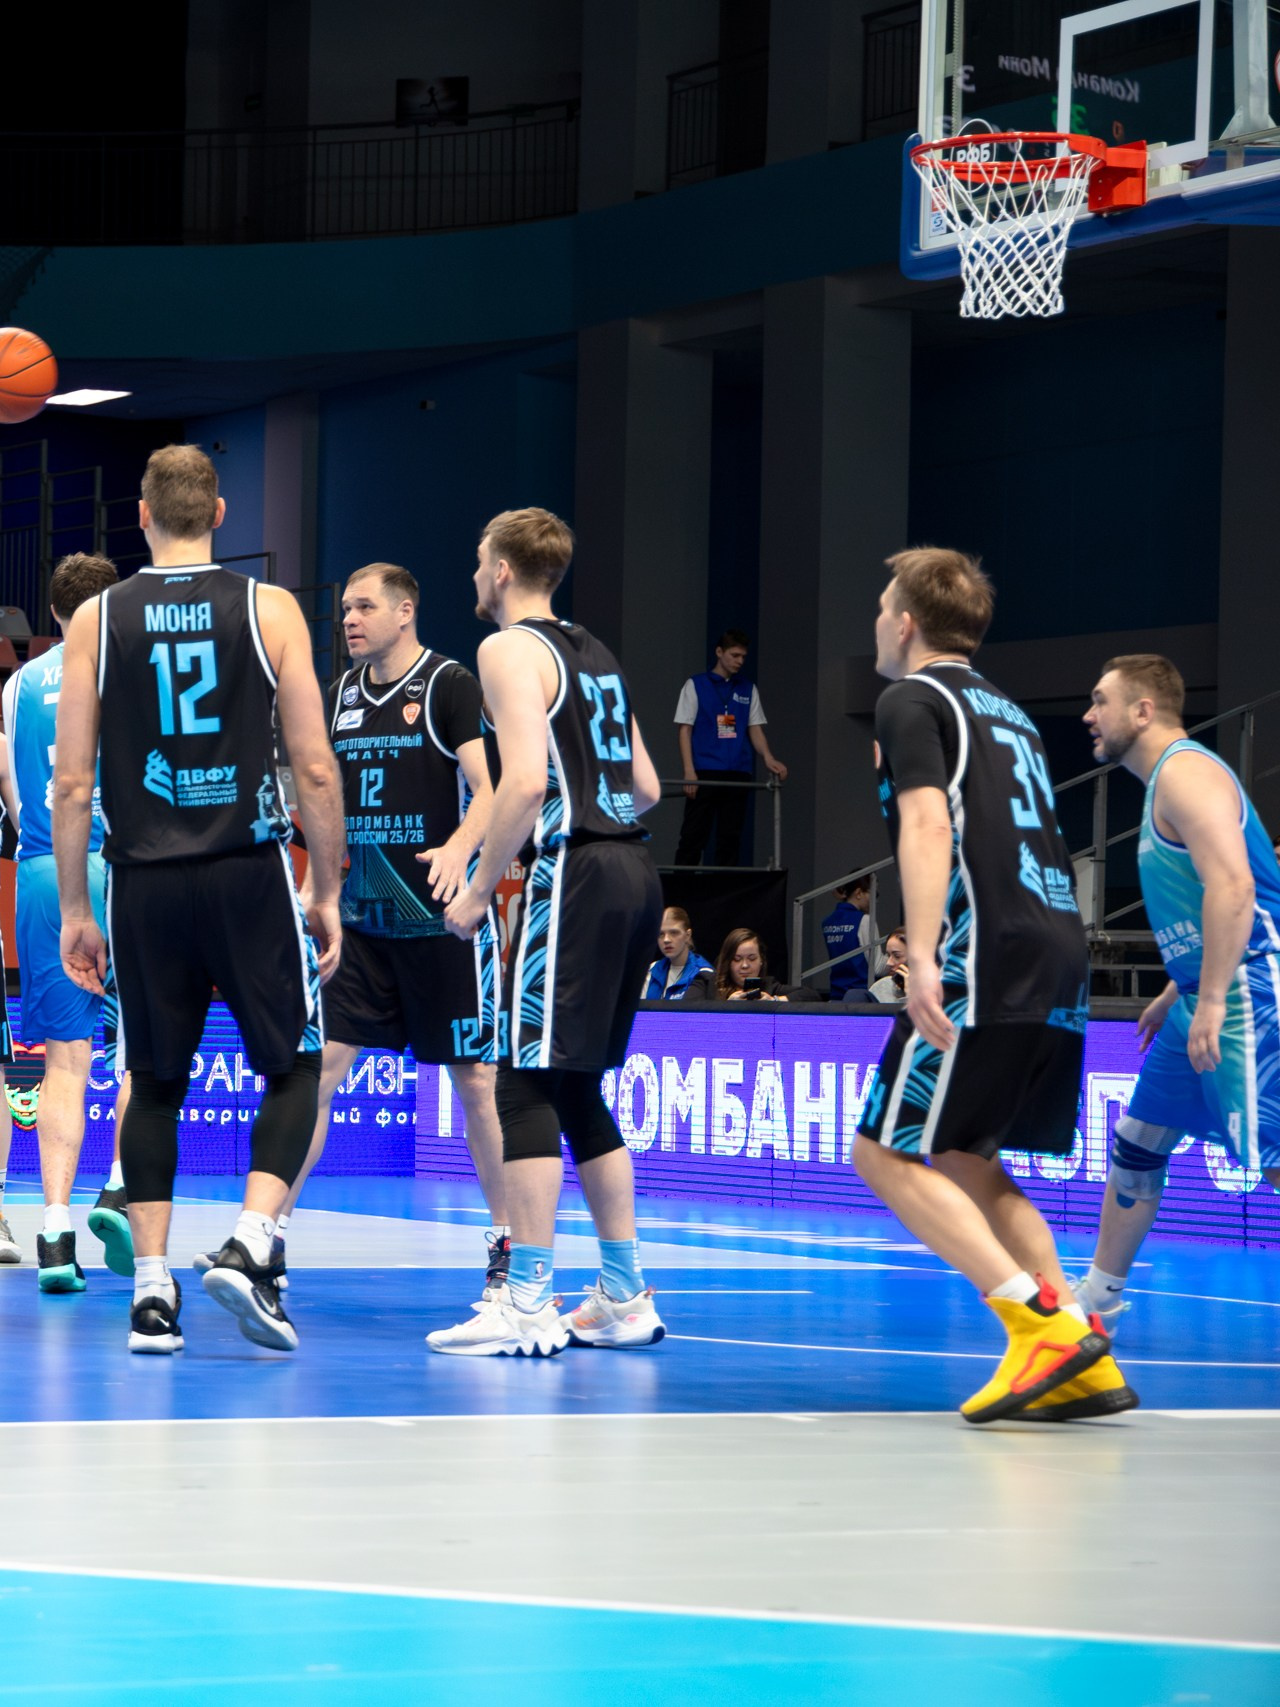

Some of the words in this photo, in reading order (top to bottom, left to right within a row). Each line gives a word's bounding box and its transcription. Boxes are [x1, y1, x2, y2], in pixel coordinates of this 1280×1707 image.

[144, 602, 212, 632] МОНЯ
[149, 640, 221, 736] 12
[578, 672, 632, 761] 23
[347, 749, 399, 760] МАТЧ
[176, 765, 237, 786] ДВФУ
[360, 768, 384, 807] 12
[389, 829, 424, 844] 25/26
[451, 1018, 480, 1057] 12
